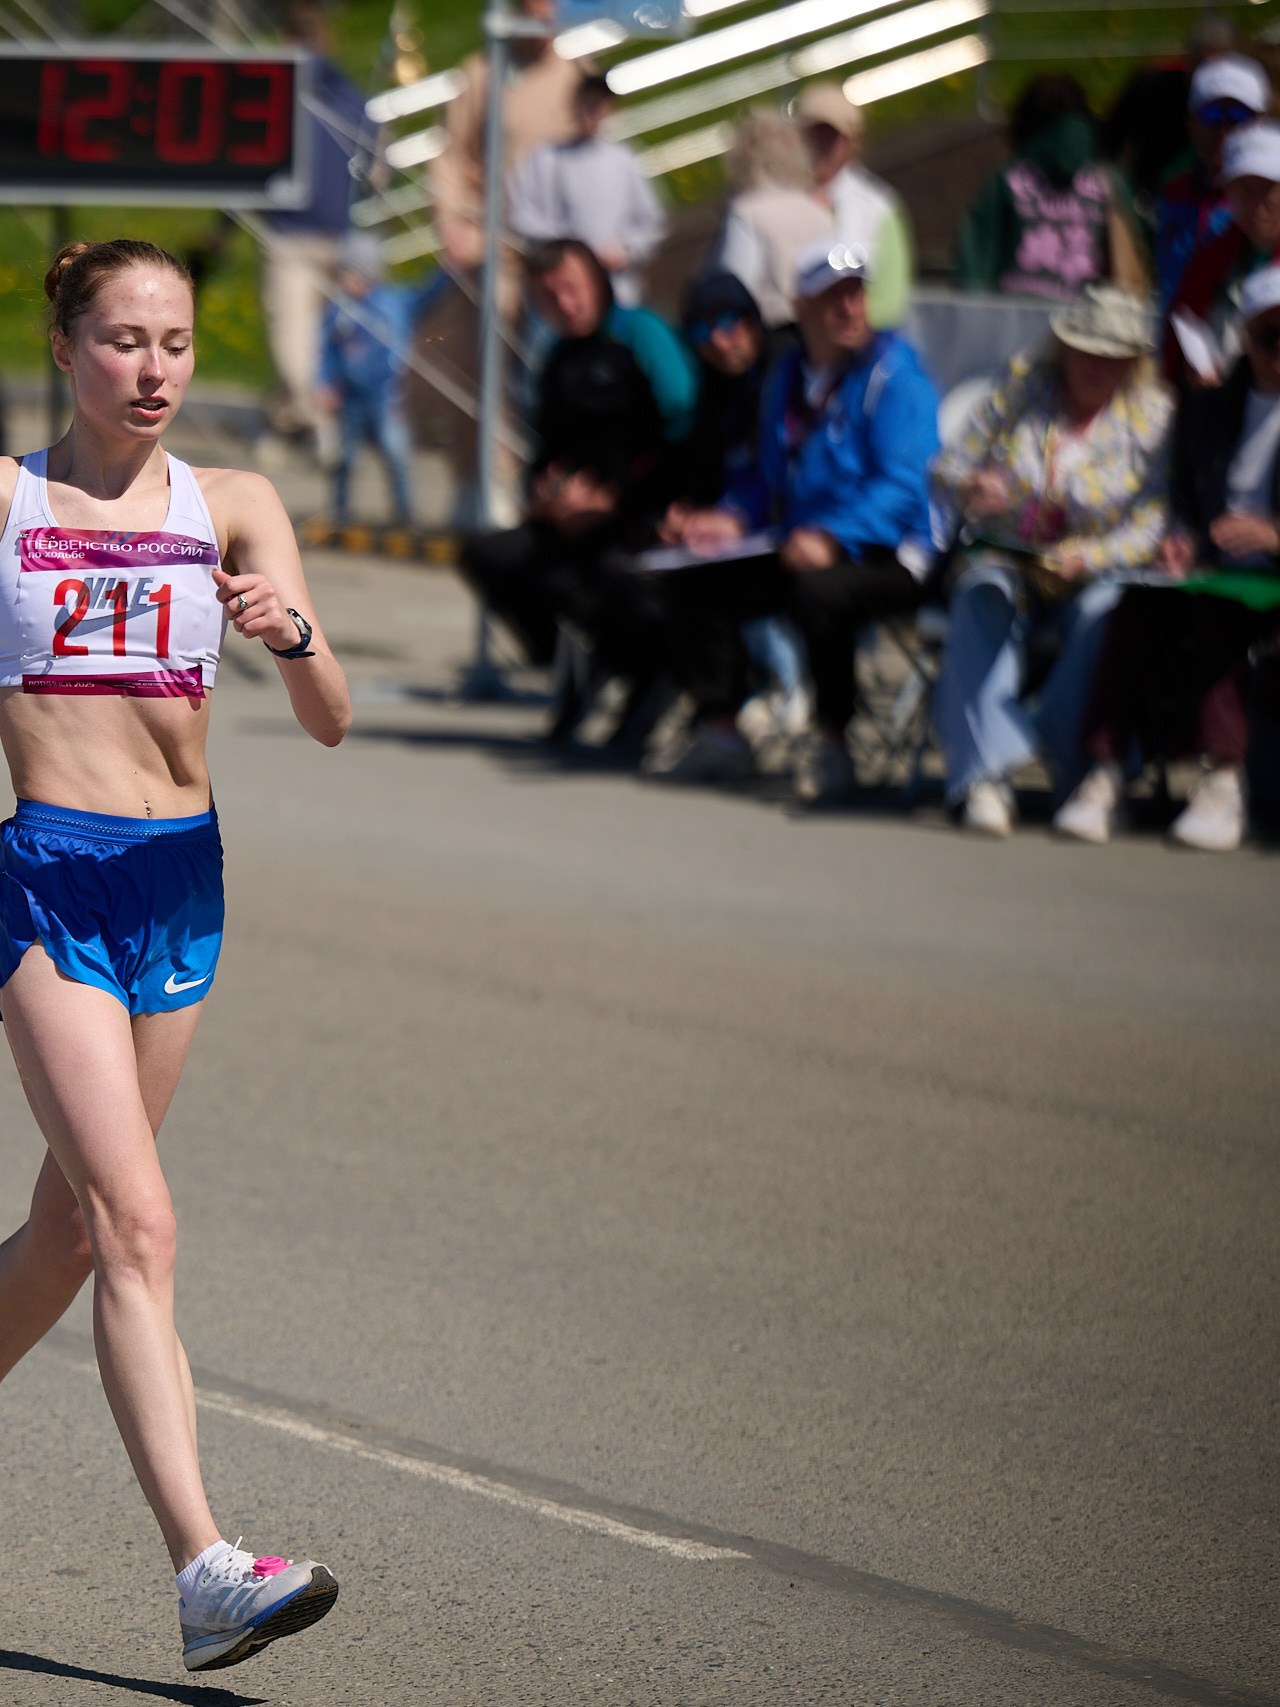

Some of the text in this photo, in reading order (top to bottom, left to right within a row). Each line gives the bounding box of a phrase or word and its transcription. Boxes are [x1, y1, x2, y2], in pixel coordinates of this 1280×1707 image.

[27, 539, 203, 557] ПЕРВЕНСТВО РОССИИ
[45, 550, 86, 560] ходьбе
[52, 578, 171, 659] 211
